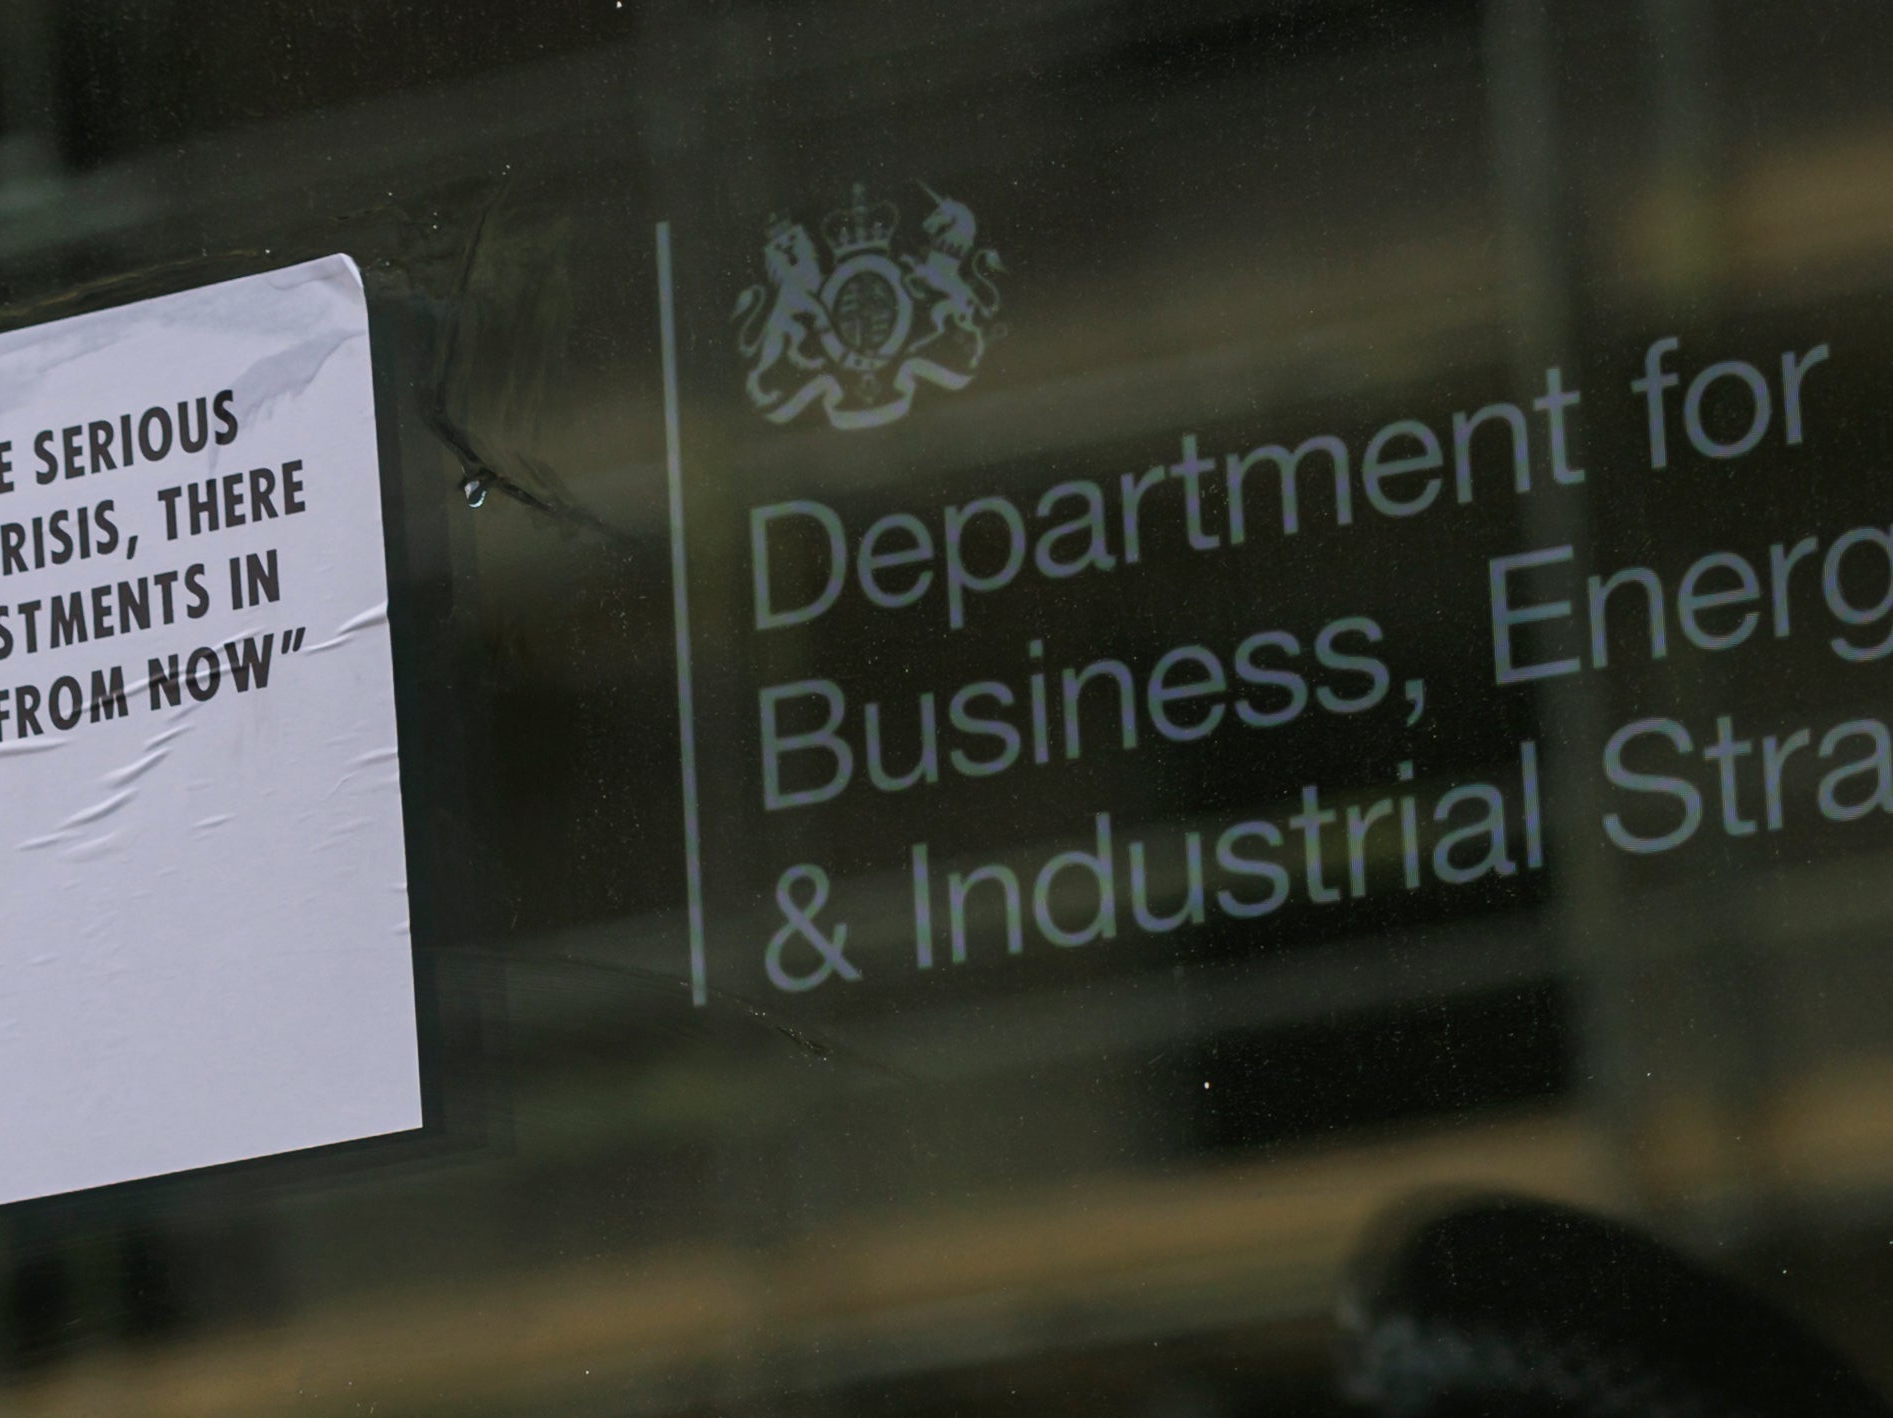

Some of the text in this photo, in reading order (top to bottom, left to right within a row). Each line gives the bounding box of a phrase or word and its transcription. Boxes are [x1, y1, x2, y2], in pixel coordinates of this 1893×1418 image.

[34, 390, 238, 484] SERIOUS
[158, 460, 305, 540] THERE
[751, 338, 1831, 630] Department for
[230, 549, 279, 610] IN
[759, 616, 1426, 812] Business,
[764, 864, 862, 993] &
[912, 741, 1544, 970] Industrial
